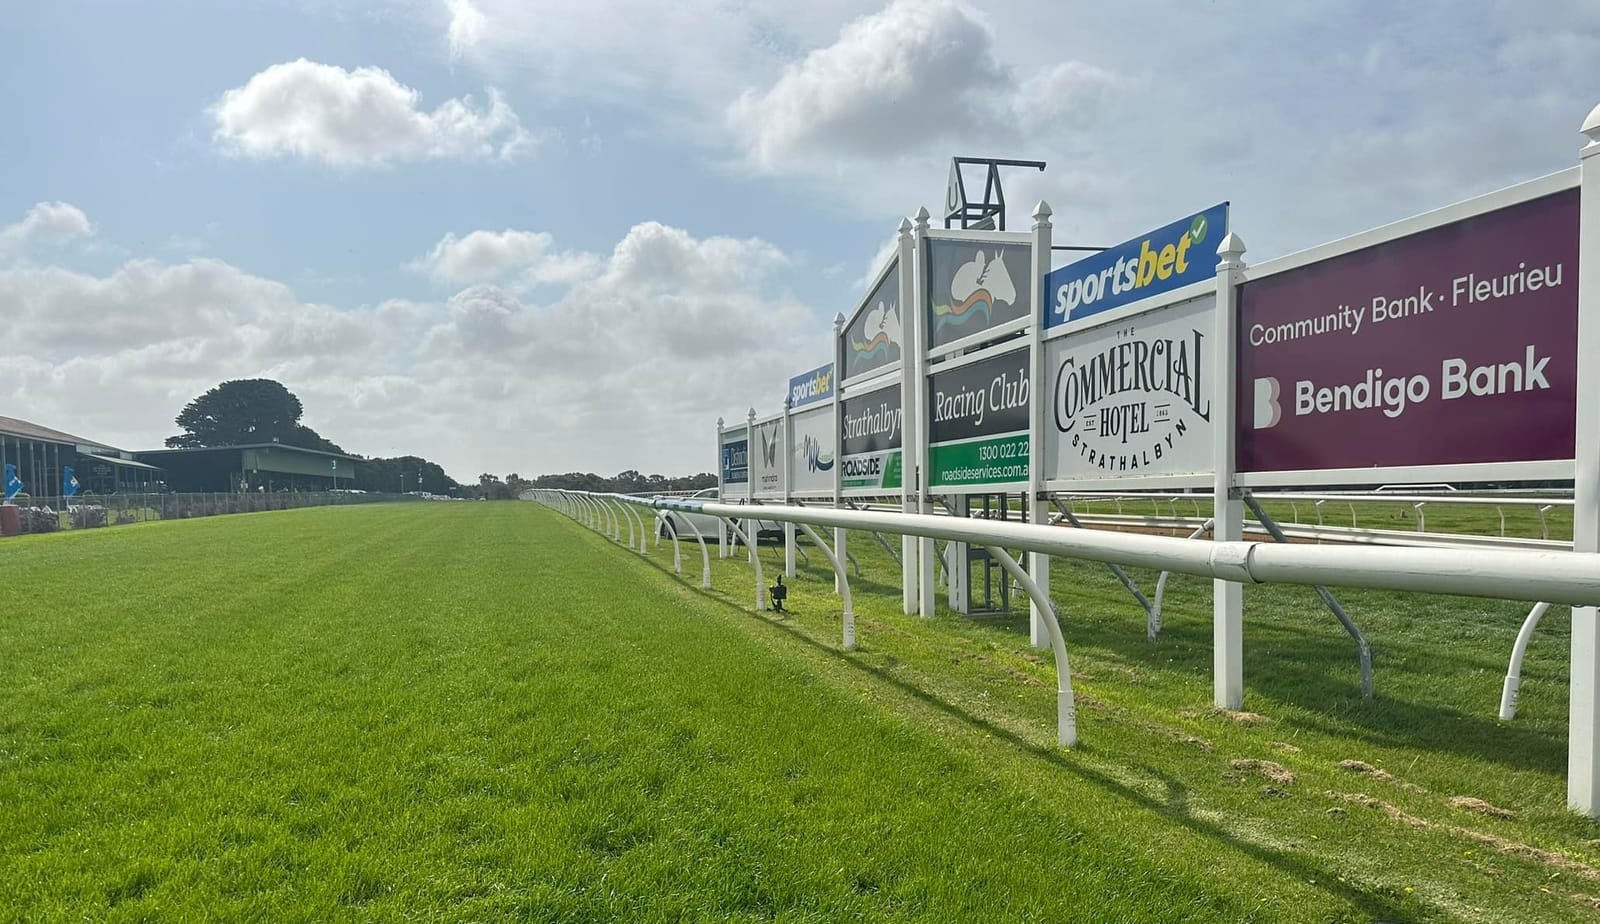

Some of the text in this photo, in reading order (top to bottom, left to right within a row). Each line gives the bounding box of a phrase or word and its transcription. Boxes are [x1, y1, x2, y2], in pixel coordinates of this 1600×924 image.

[1054, 230, 1193, 323] sportsbet
[1249, 262, 1563, 347] Community Bank Fleurieu
[1116, 327, 1135, 339] THE
[792, 371, 829, 407] sportsbet
[934, 368, 1029, 426] Racing Club
[1295, 345, 1551, 418] Bendigo Bank
[1072, 418, 1187, 471] STRATHALBYN
[1100, 402, 1149, 443] HOTEL
[842, 458, 880, 476] ROADSIDE
[979, 445, 998, 460] 1300
[1000, 443, 1016, 458] 022
